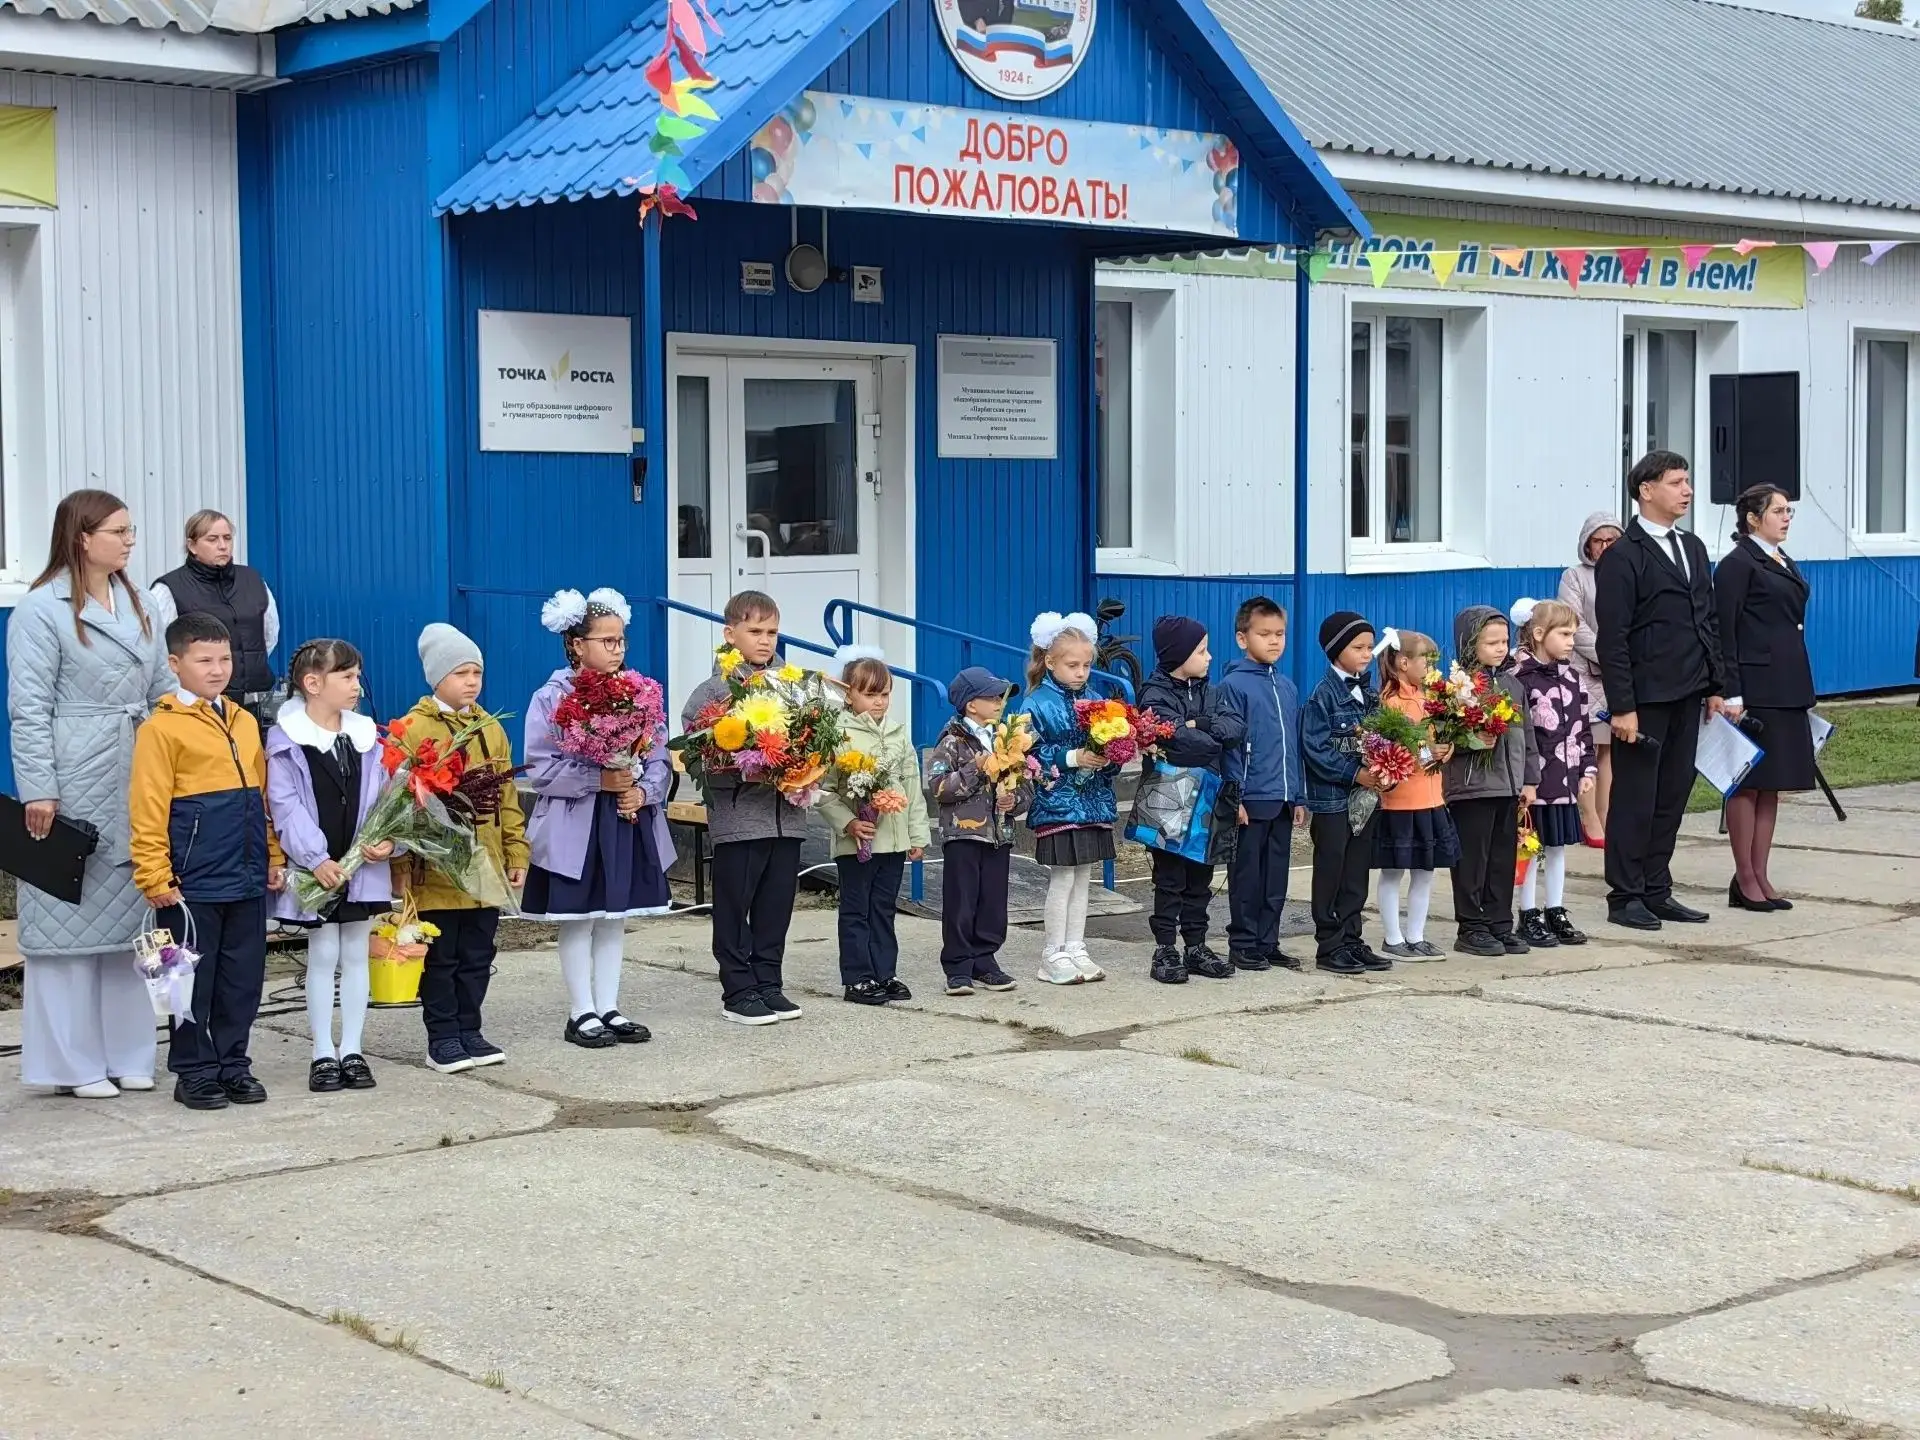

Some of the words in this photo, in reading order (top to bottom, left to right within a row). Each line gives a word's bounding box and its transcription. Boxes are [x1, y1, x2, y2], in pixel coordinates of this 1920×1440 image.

[998, 69, 1024, 84] 1924
[959, 118, 1068, 166] ДОБРО
[893, 164, 1129, 219] ПОЖАЛОВАТЬ!
[497, 367, 547, 381] ТОЧКА
[570, 370, 615, 384] РОСТА
[502, 400, 525, 410] Центр
[526, 402, 573, 410] образования
[574, 404, 613, 412] цифрового
[509, 412, 562, 420] гуманитарного
[563, 412, 600, 421] профилей
